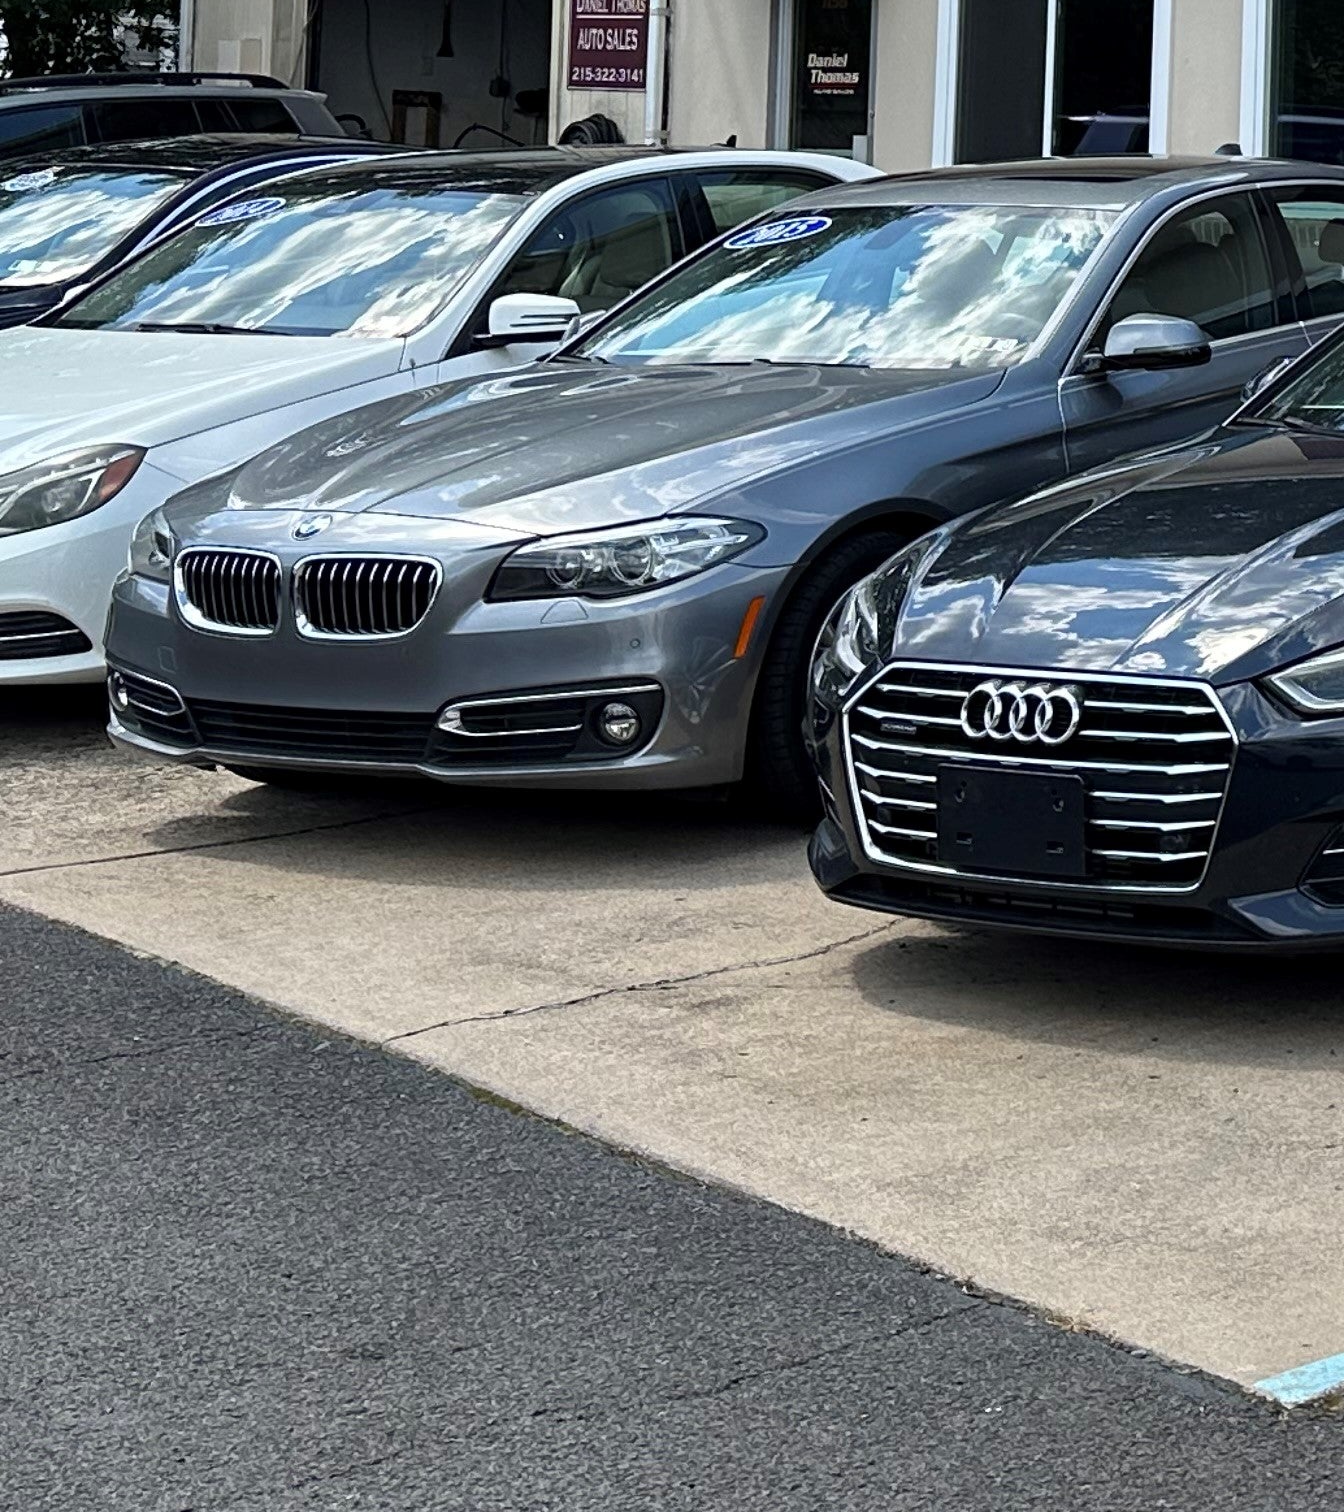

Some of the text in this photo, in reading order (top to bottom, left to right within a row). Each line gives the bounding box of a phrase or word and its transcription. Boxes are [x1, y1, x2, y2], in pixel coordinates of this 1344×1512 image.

[577, 28, 639, 51] AUTO SALES
[806, 53, 848, 68] Daniel
[571, 66, 644, 83] 215-322-3141
[811, 69, 860, 84] Thomas
